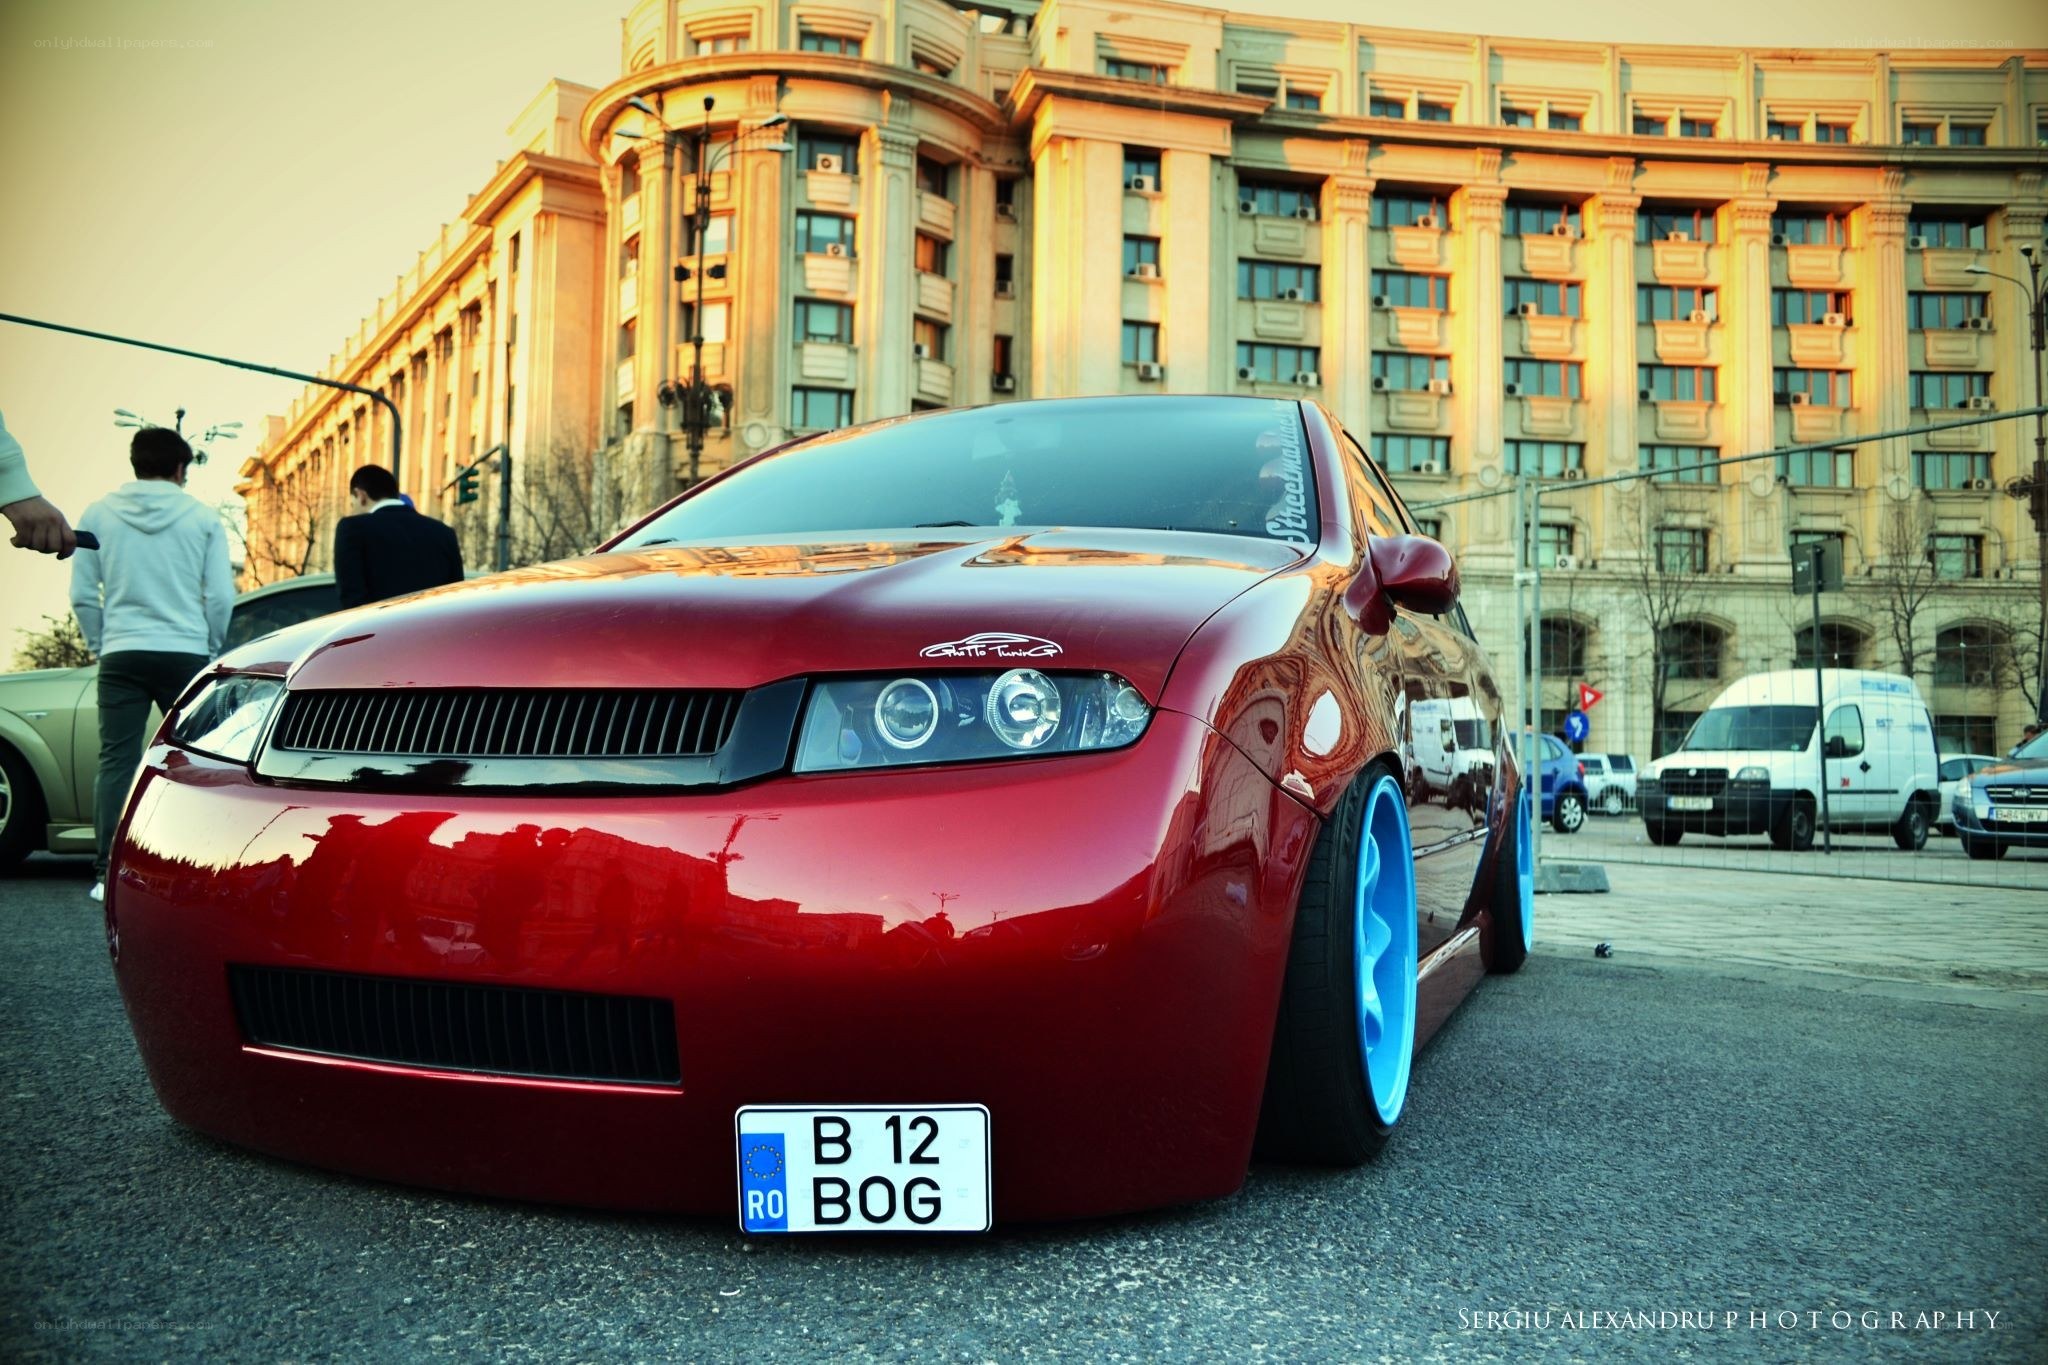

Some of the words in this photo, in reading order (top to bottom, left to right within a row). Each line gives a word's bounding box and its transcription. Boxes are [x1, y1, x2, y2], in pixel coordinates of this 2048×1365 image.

[813, 1116, 852, 1165] B
[885, 1115, 940, 1165] 12
[747, 1189, 784, 1220] RO
[813, 1175, 942, 1225] BOG
